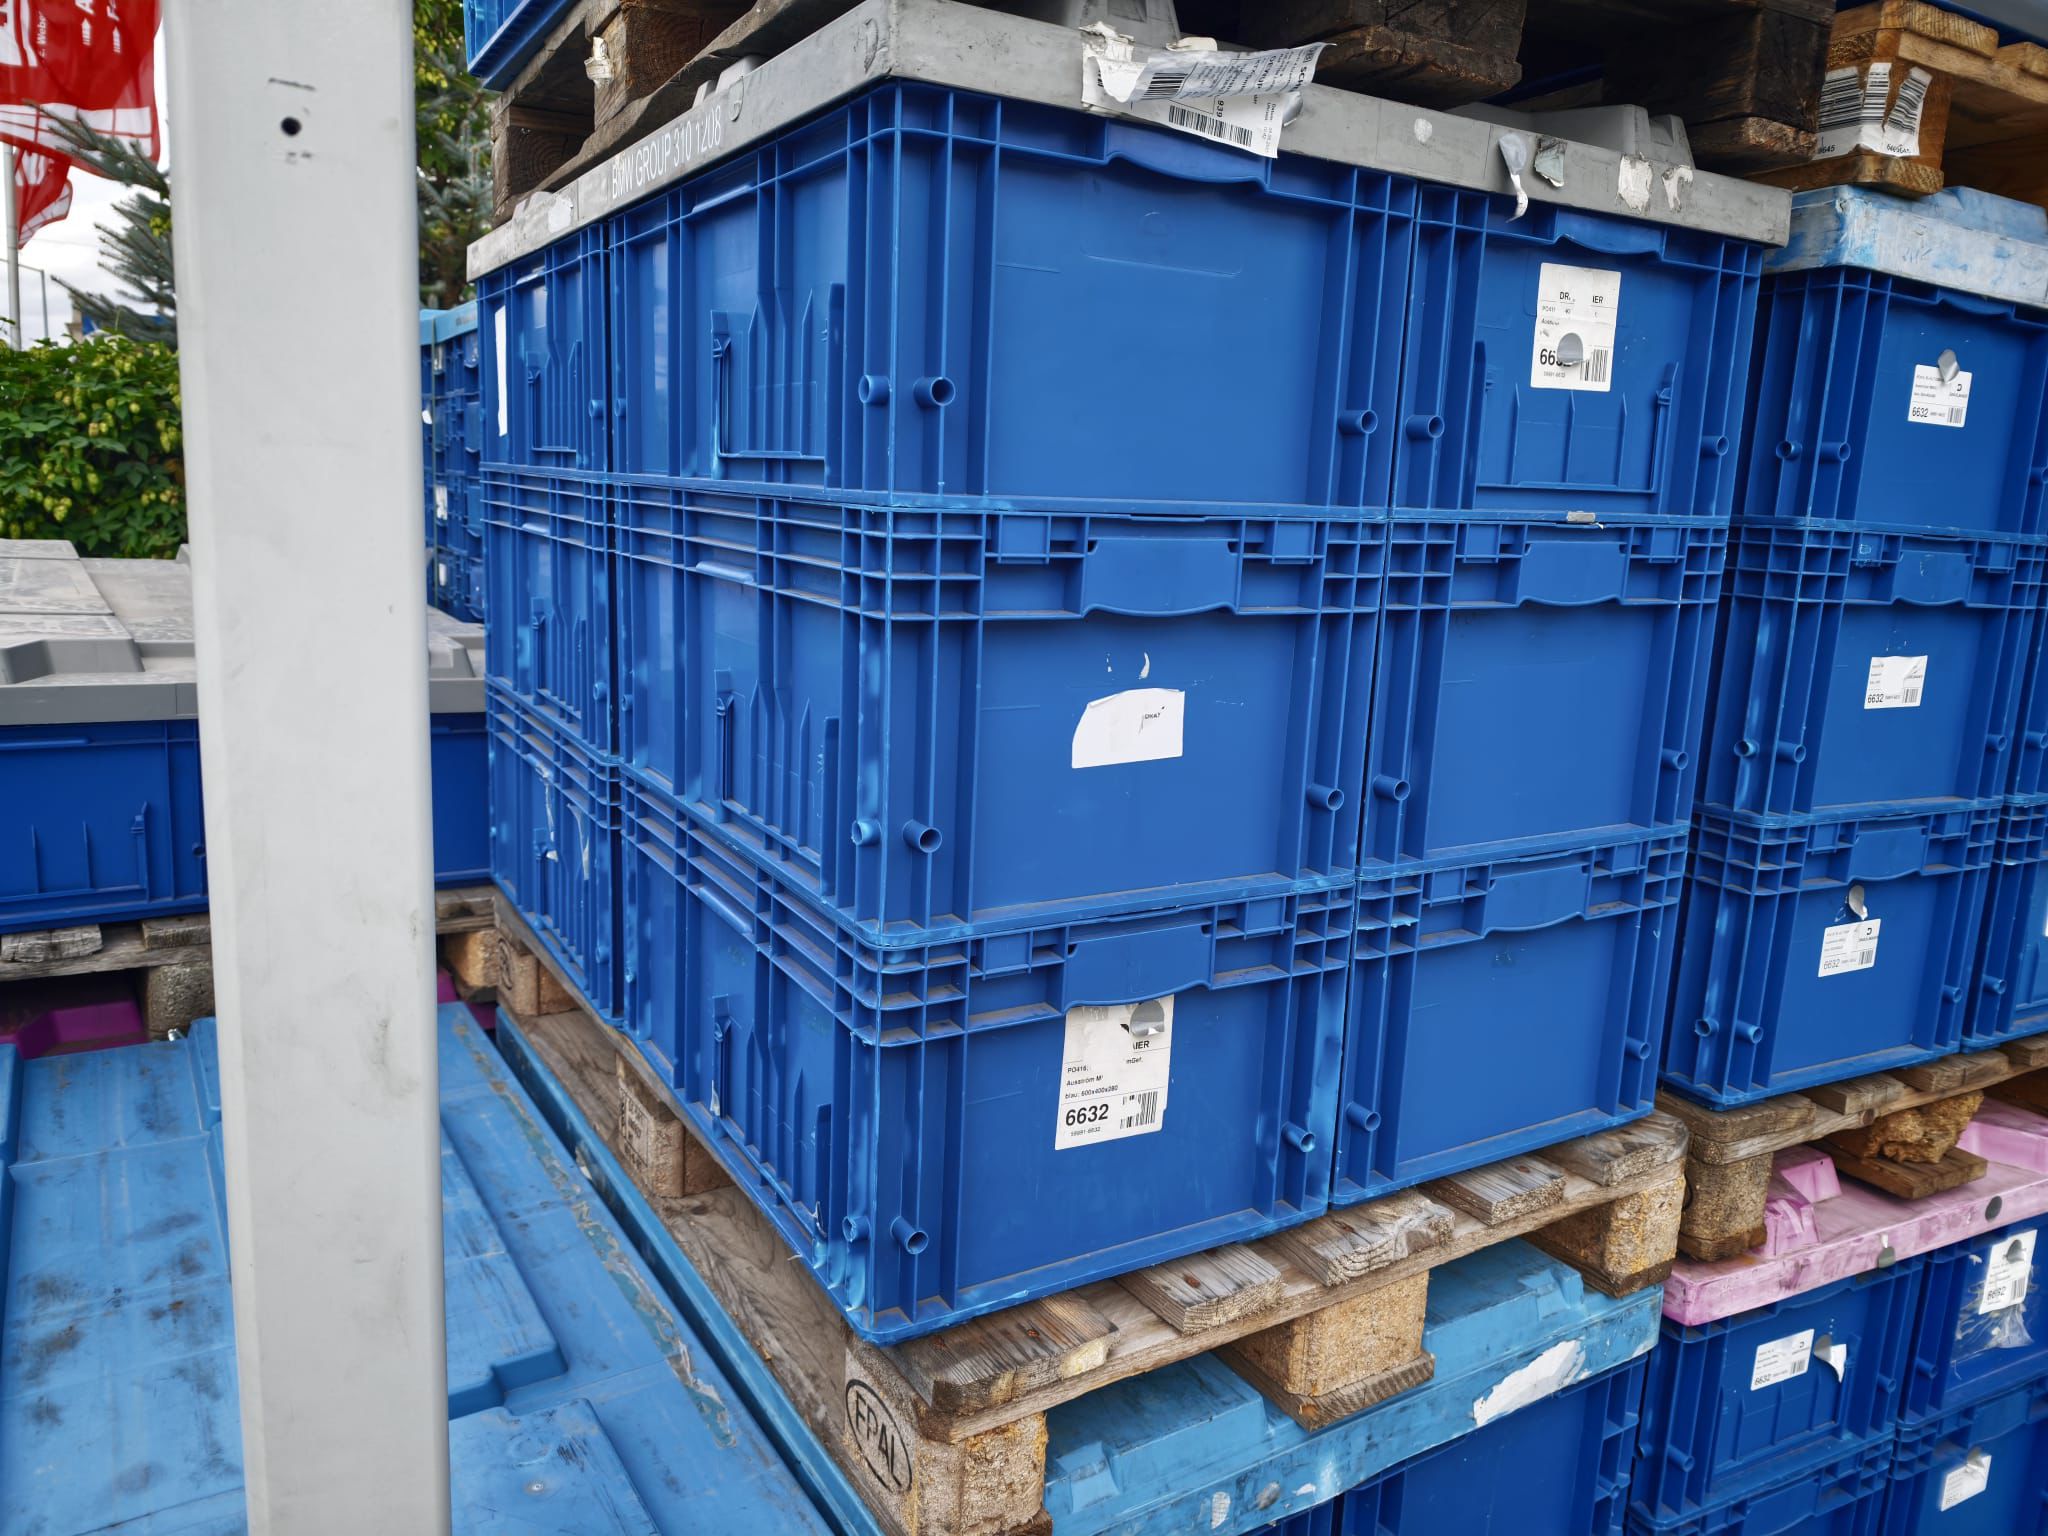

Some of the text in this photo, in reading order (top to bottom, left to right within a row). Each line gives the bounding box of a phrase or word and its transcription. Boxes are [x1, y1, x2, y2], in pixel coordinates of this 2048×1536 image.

[612, 105, 721, 199] BMW GROUP 310 1208
[1867, 693, 1884, 704] 6632
[1065, 1103, 1110, 1127] 6632
